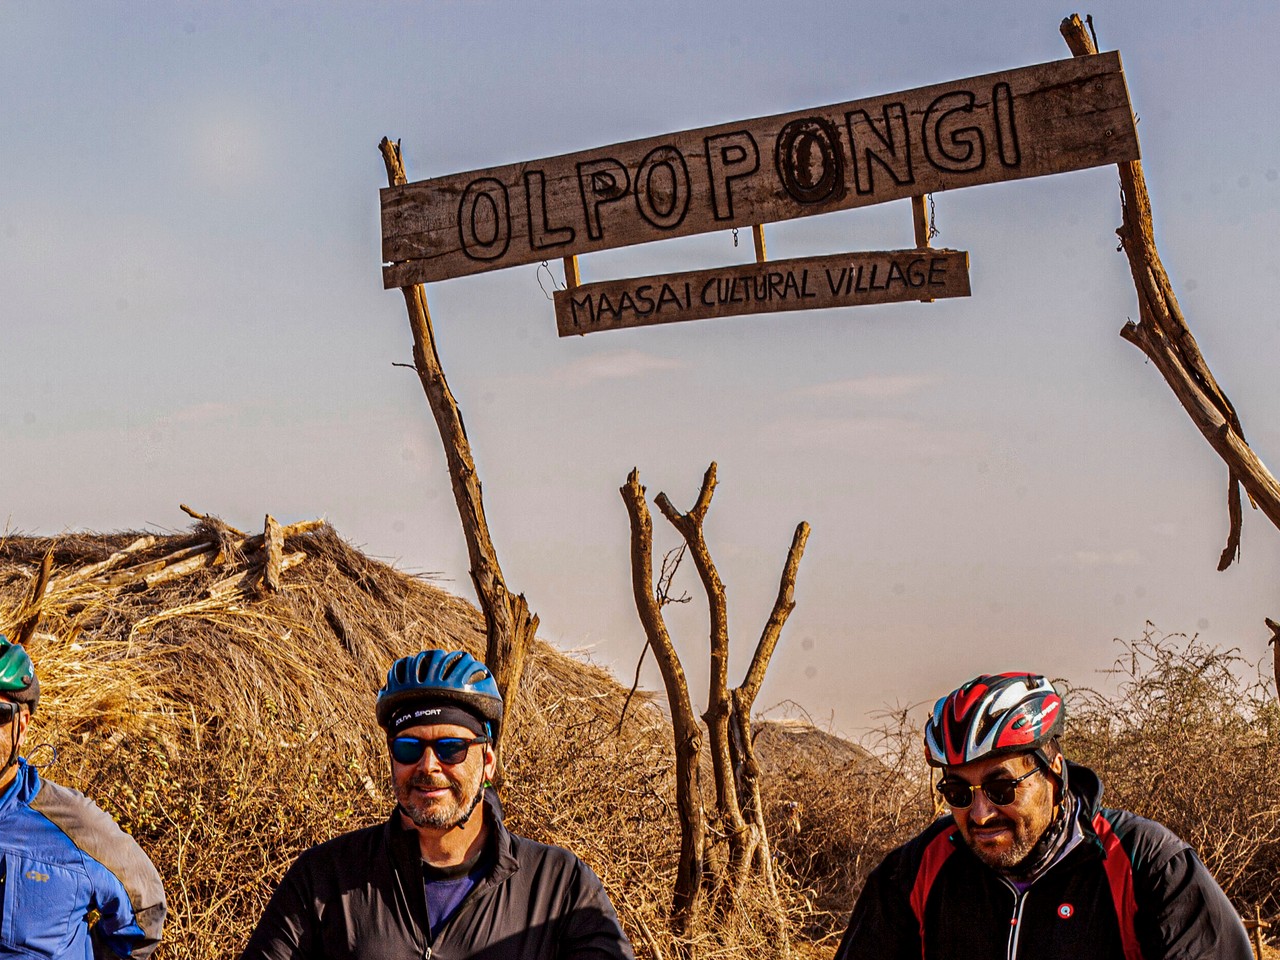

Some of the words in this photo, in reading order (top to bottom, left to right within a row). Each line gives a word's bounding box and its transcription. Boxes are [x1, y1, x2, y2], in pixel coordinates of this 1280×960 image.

[458, 82, 1021, 262] OLPOPONGI
[570, 282, 691, 328] MAASAI
[700, 269, 816, 307] CULTURAL
[825, 256, 949, 297] VILLAGE
